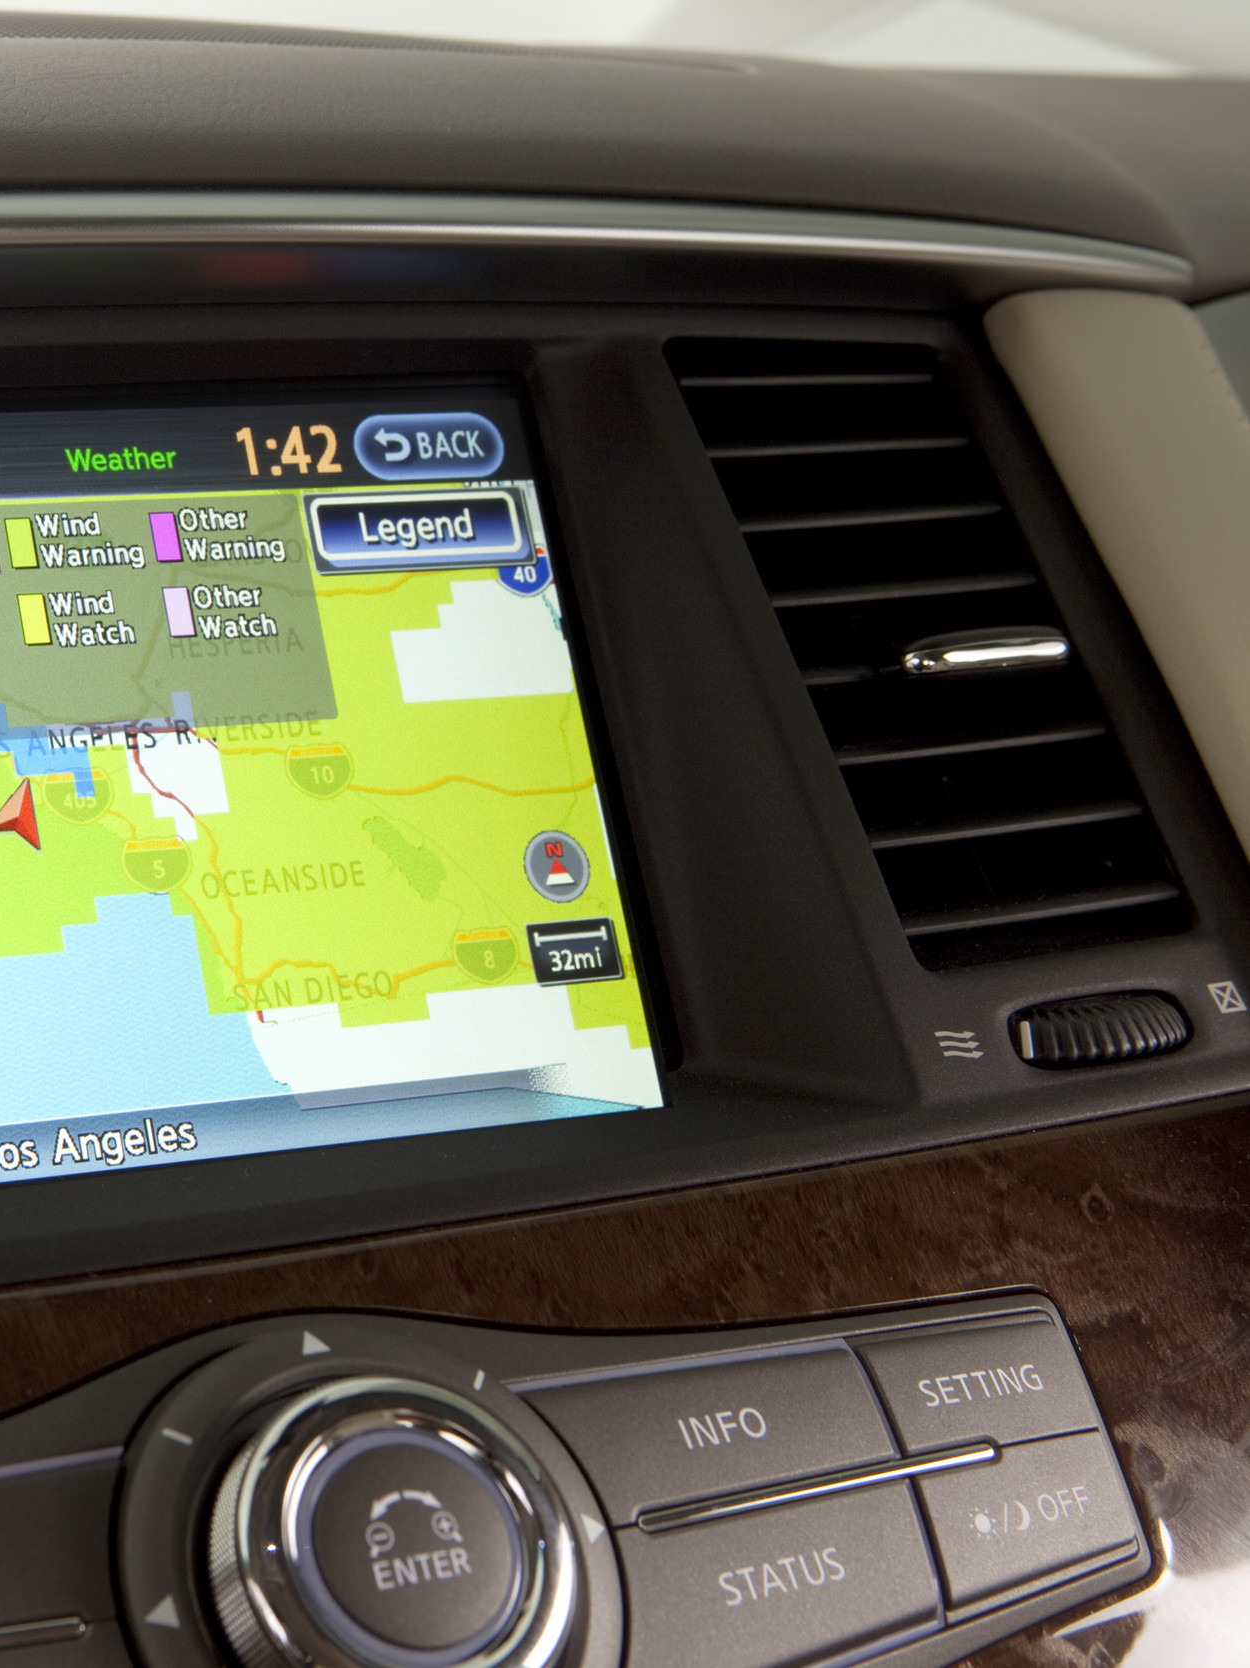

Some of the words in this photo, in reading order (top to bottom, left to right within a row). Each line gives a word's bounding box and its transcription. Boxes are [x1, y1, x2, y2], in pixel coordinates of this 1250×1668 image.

[236, 425, 343, 477] 1:42
[415, 430, 486, 460] BACK
[65, 447, 176, 473] Weather
[34, 512, 101, 538] Wind
[178, 508, 247, 531] Other
[359, 509, 475, 548] Legend
[40, 542, 145, 569] Warning
[184, 536, 286, 562] Warning
[513, 565, 537, 584] 40
[49, 590, 115, 617] Wind
[192, 584, 262, 609] Other
[53, 619, 136, 647] Watch
[198, 613, 278, 639] Watch
[310, 765, 334, 784] 10
[545, 842, 564, 859] N
[153, 859, 166, 880] 5
[200, 861, 367, 899] OCEANSIDE
[484, 950, 496, 969] 8
[549, 946, 603, 972] 32mi
[232, 982, 295, 1010] SAN
[306, 969, 391, 1005] DIEGO
[52, 1118, 198, 1167] Angeles
[917, 1363, 1044, 1407] SETTING
[677, 1407, 768, 1450] INFO
[1037, 1485, 1089, 1521] OFF
[372, 1547, 473, 1591] ENTER
[717, 1547, 846, 1606] STATUS
